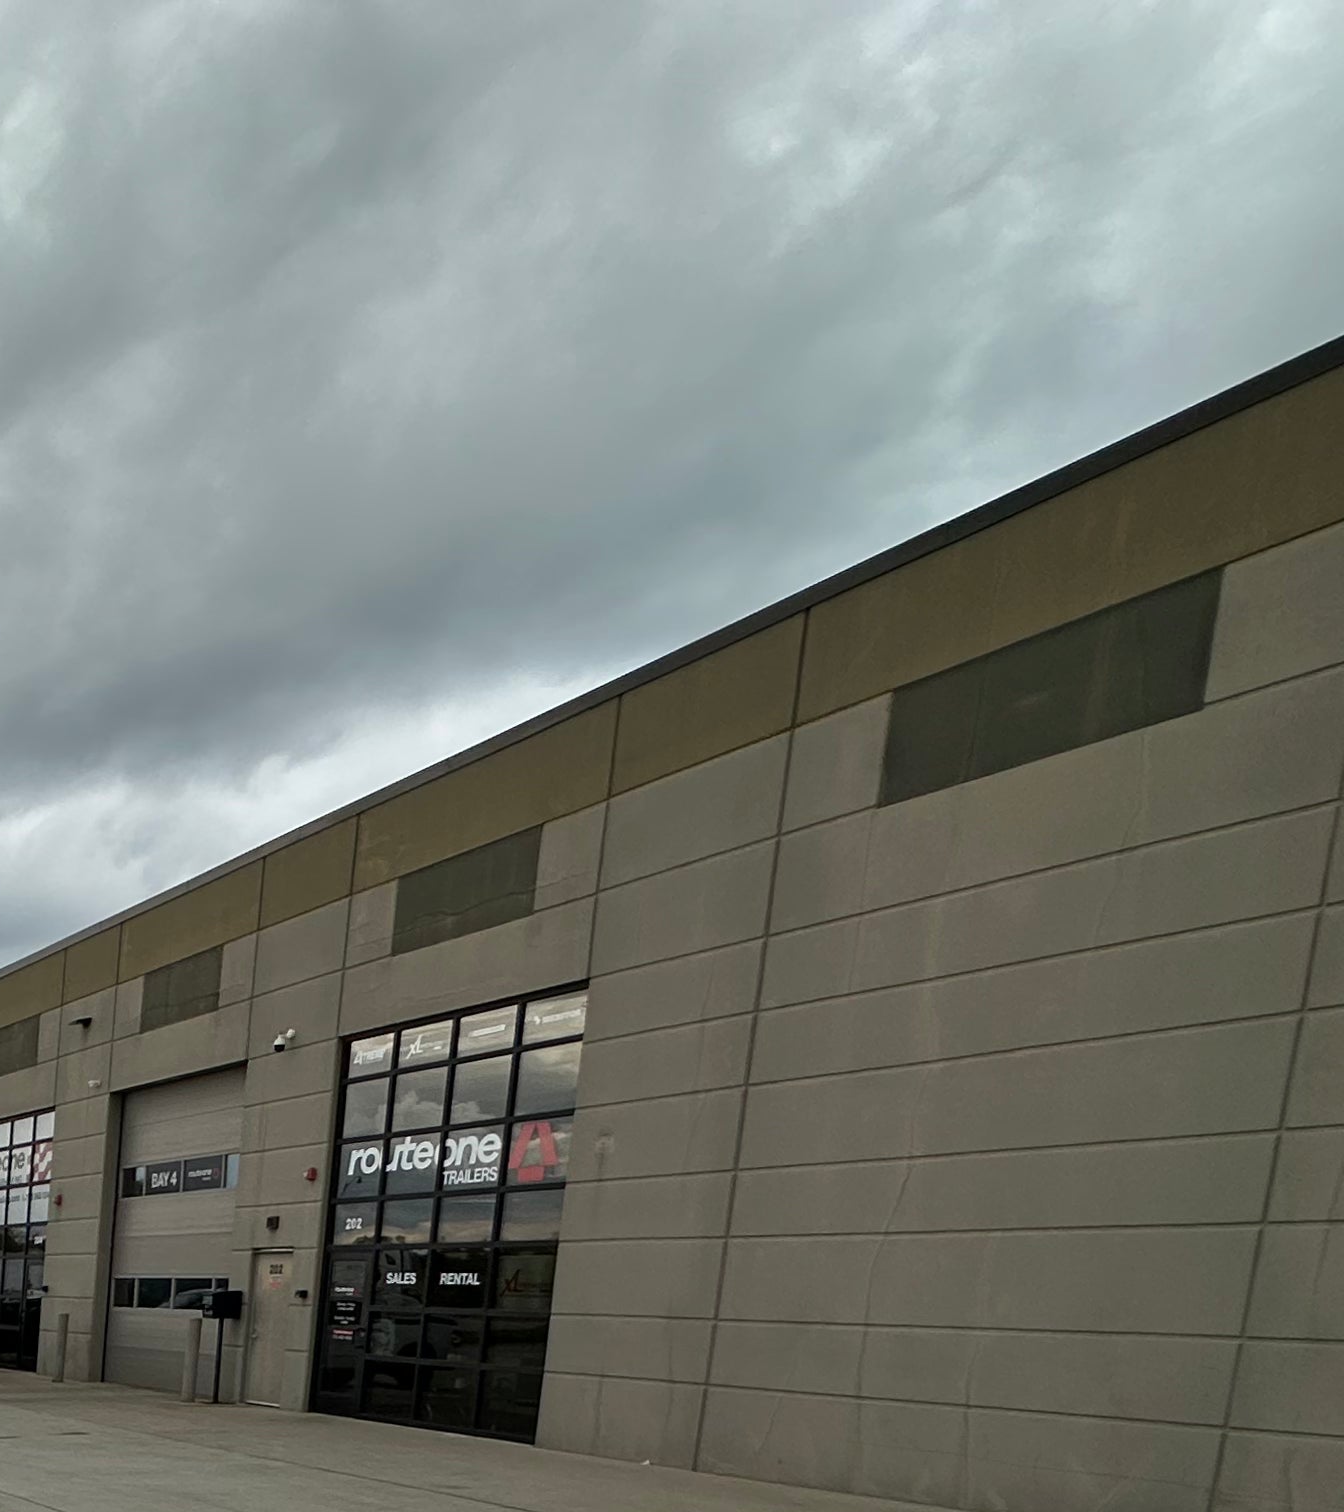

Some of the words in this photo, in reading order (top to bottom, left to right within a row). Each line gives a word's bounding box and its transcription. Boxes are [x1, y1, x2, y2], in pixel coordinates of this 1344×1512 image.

[347, 1133, 502, 1176] routeone
[151, 1172, 170, 1188] BAY
[170, 1171, 177, 1186] 4
[443, 1167, 498, 1185] TRAILERS
[345, 1218, 362, 1230] 202
[386, 1273, 416, 1285] SALES
[439, 1273, 481, 1286] RENTAL
